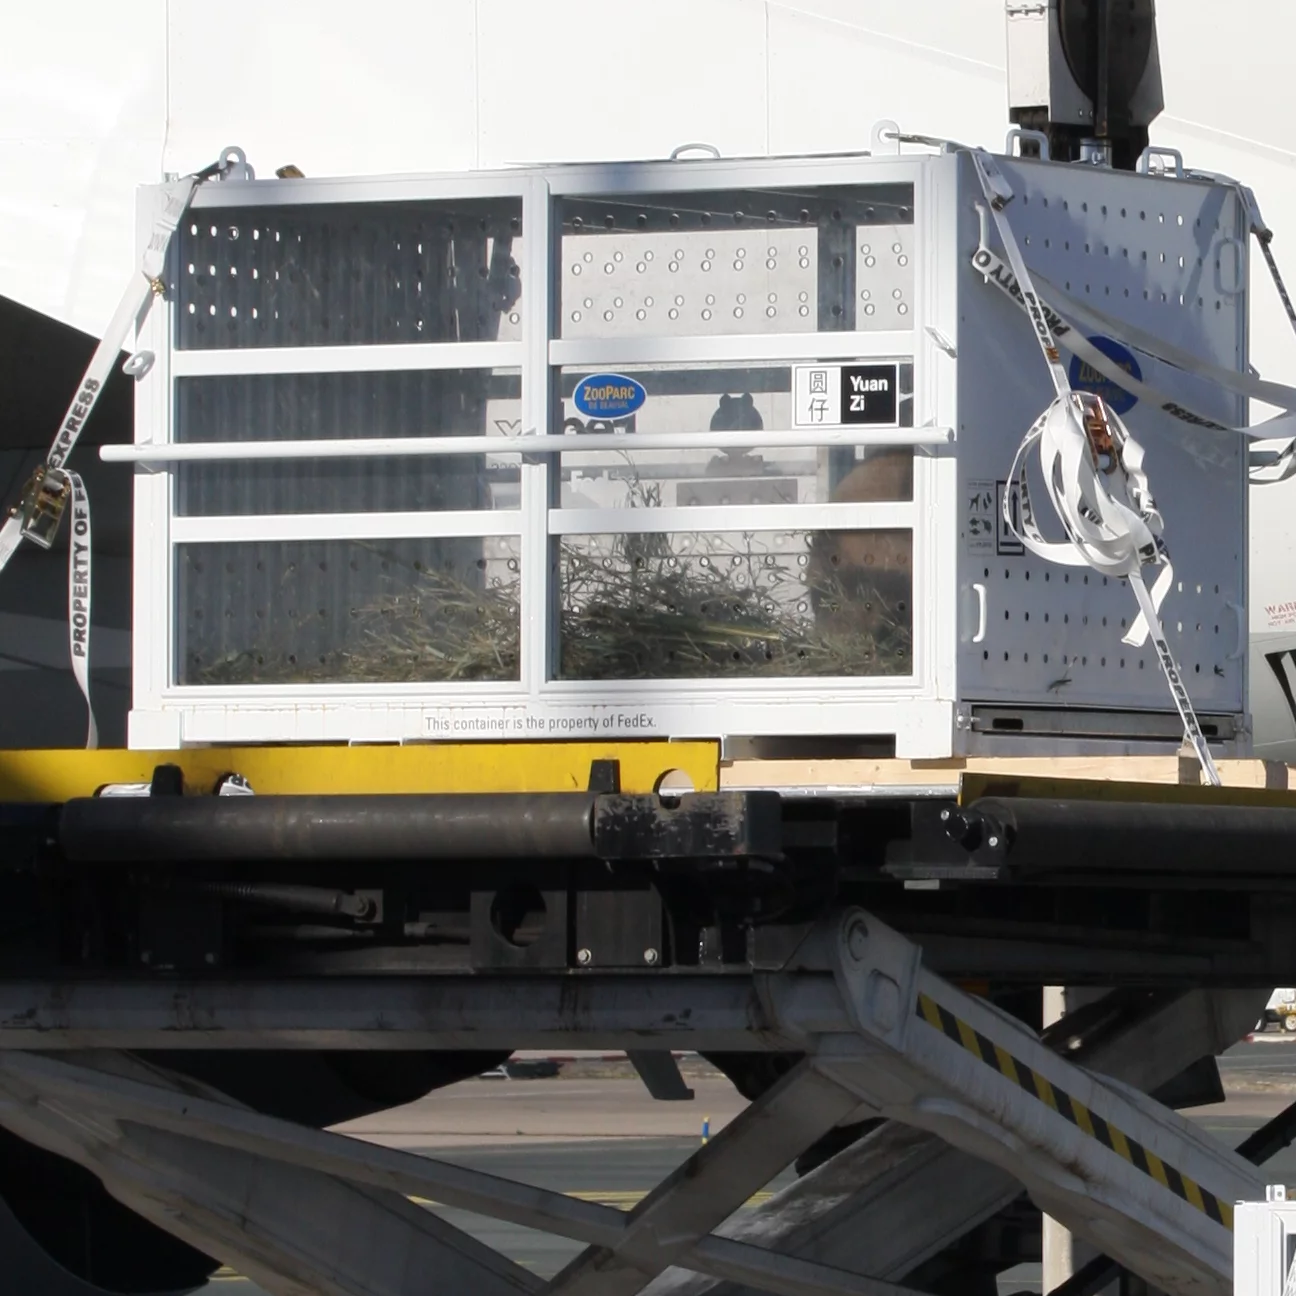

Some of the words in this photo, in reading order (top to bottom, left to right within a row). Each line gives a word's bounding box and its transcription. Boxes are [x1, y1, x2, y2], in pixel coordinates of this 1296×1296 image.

[850, 375, 888, 391] Yuan
[850, 395, 865, 411] Zi
[74, 505, 89, 536] OF
[73, 541, 89, 657] PROPERTY
[425, 716, 450, 731] This
[453, 716, 509, 731] container
[513, 716, 523, 730] is
[526, 714, 545, 730] the
[549, 715, 600, 733] property
[602, 713, 615, 729] of
[617, 713, 657, 729] FedEx.
